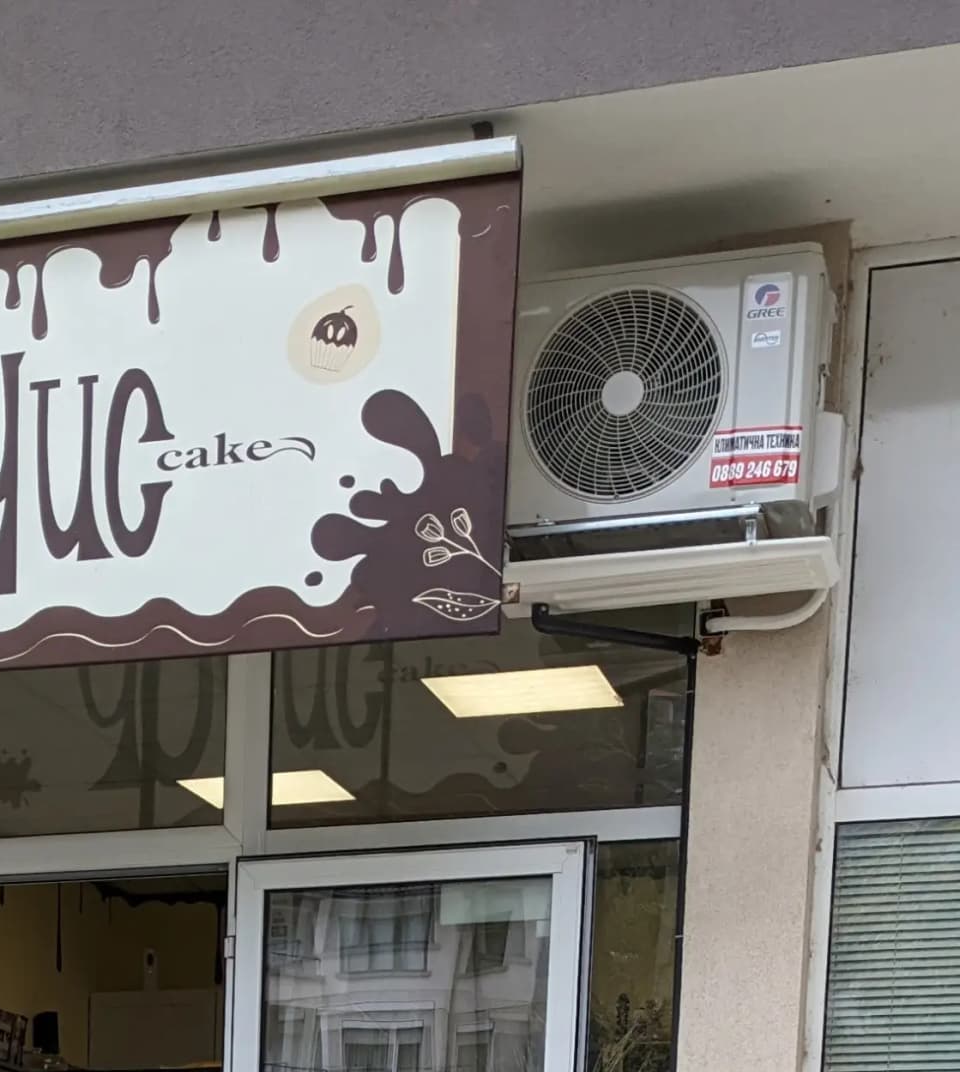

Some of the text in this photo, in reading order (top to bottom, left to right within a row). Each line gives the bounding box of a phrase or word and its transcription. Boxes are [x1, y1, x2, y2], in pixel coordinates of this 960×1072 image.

[747, 307, 785, 319] GREE
[156, 432, 315, 471] cake
[746, 460, 771, 478] 246
[773, 459, 797, 477] 679
